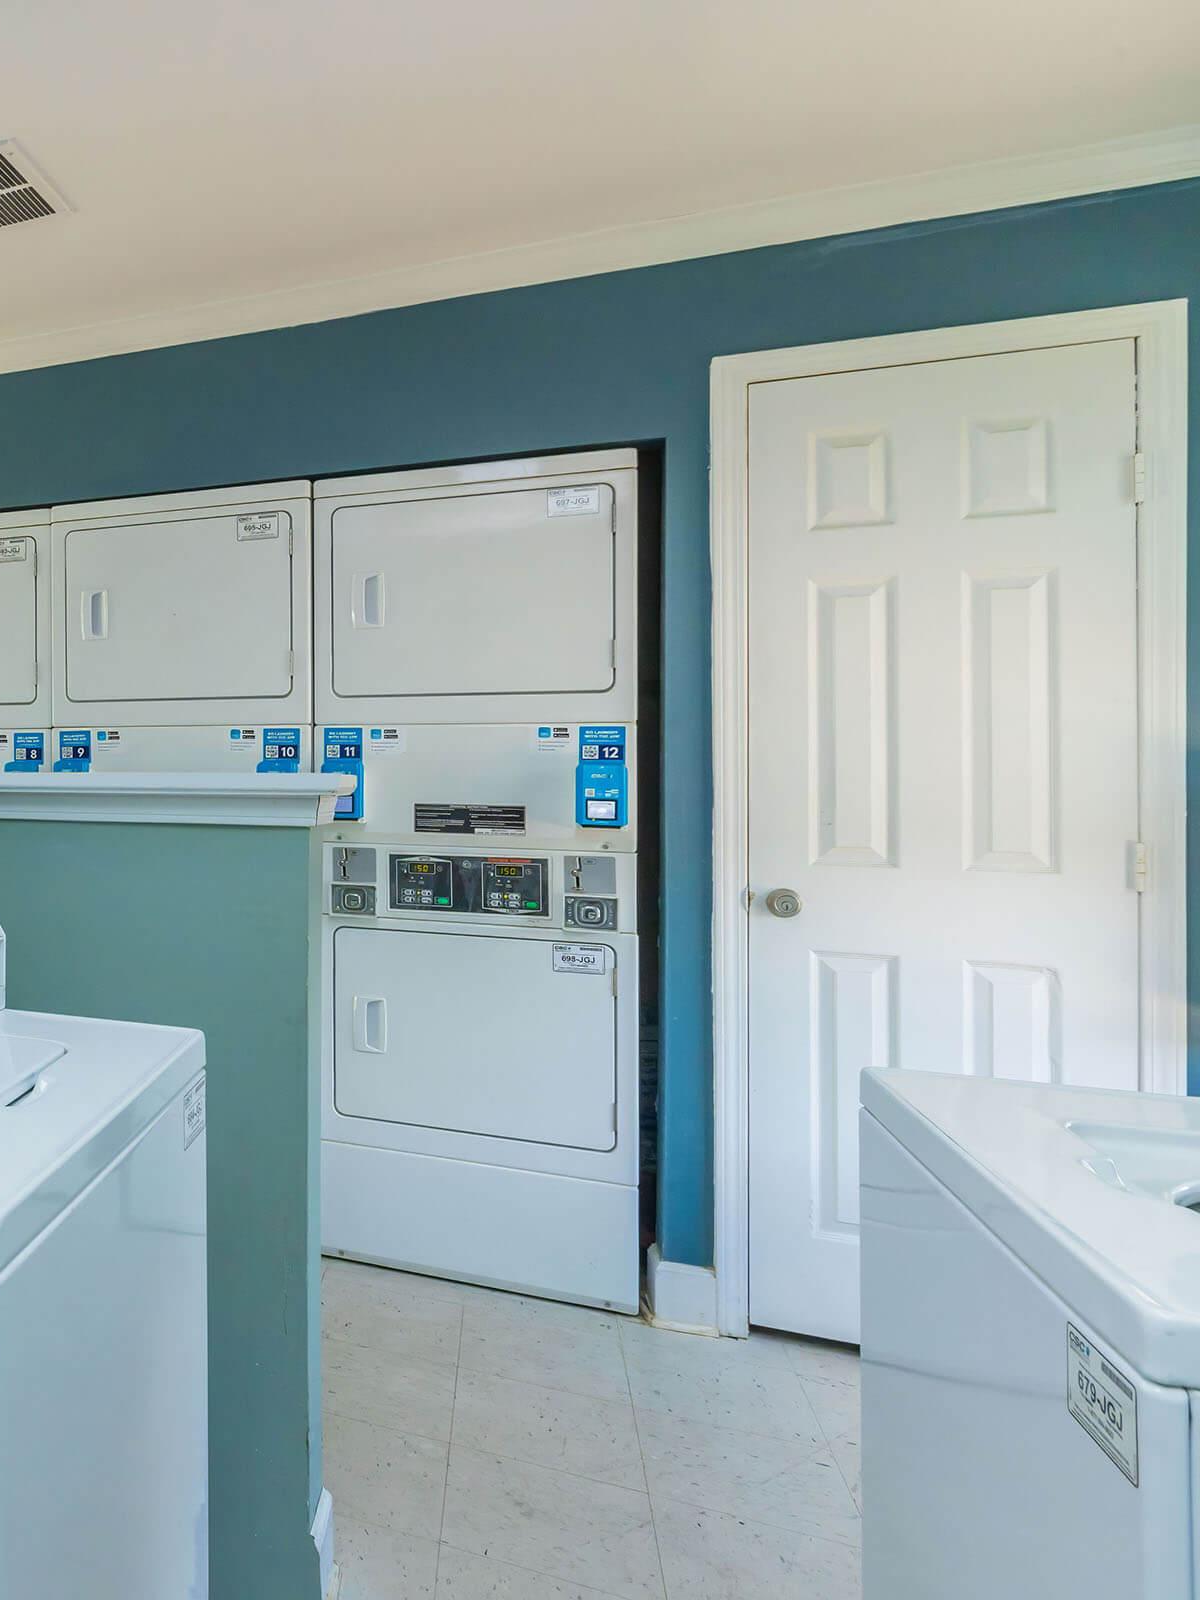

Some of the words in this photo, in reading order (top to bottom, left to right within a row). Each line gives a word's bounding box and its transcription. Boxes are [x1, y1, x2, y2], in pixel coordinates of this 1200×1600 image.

[30, 749, 38, 760] 8
[77, 747, 85, 758] 9
[280, 746, 295, 758] 10
[344, 746, 356, 757] 11
[602, 746, 619, 759] 12
[500, 867, 517, 875] 150
[1077, 1369, 1124, 1433] 679-JGJ
